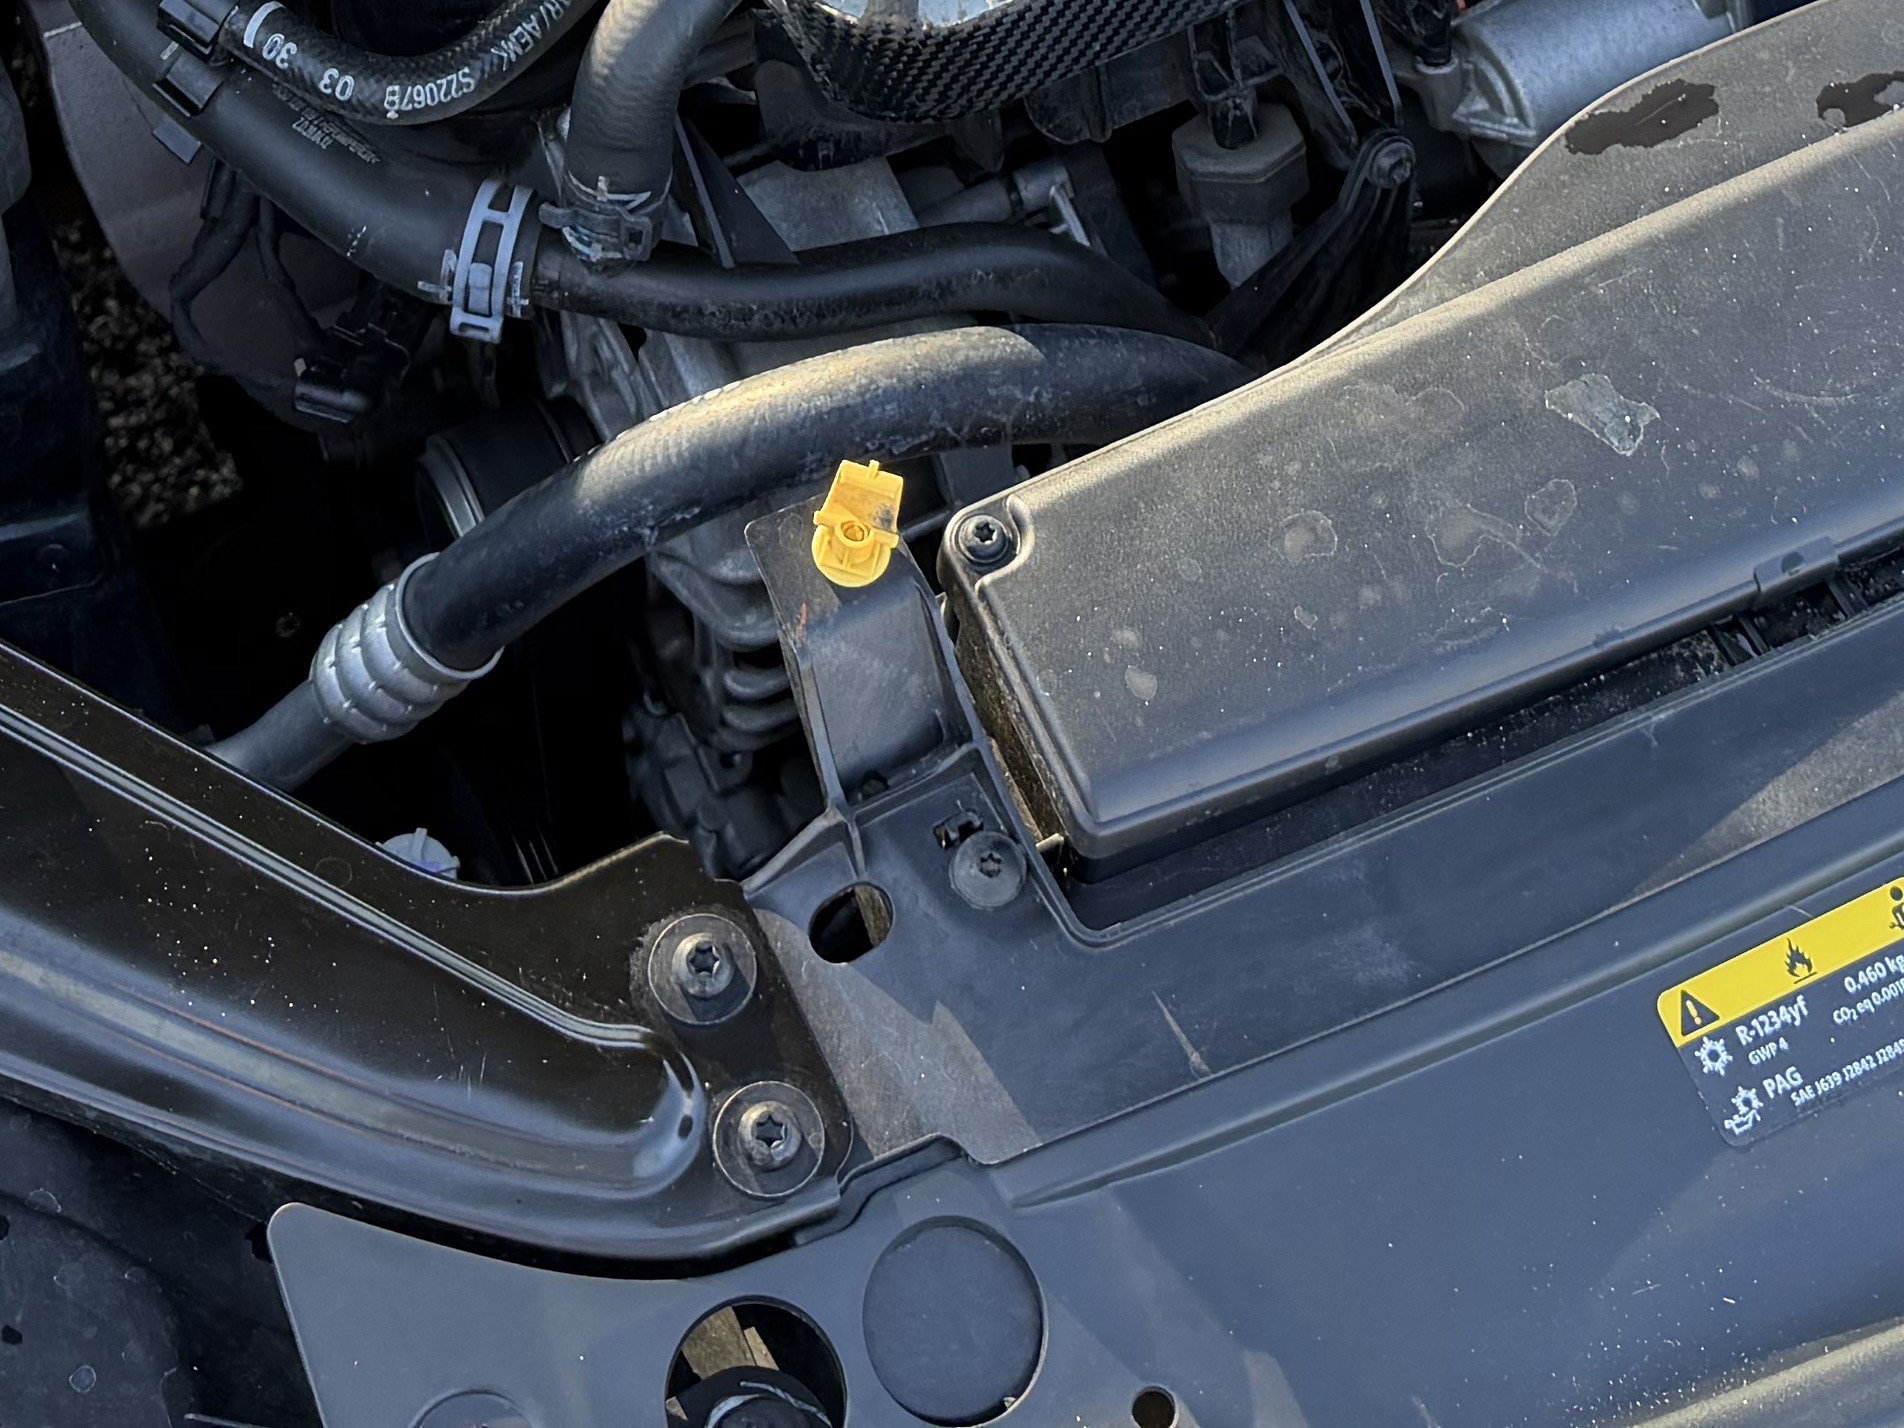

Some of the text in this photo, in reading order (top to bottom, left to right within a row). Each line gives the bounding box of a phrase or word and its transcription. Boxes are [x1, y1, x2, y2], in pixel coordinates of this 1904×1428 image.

[263, 31, 299, 68] 30
[318, 67, 354, 102] 03
[1840, 960, 1889, 995] 0.460
[1732, 993, 1815, 1051] R-1234yf
[1854, 998, 1875, 1017] eq
[1746, 1035, 1790, 1067] GWP 4
[1761, 1064, 1805, 1099] PAG
[1788, 1083, 1817, 1106] SAE
[1812, 1070, 1844, 1095] J639
[1839, 1053, 1878, 1081] J2842
